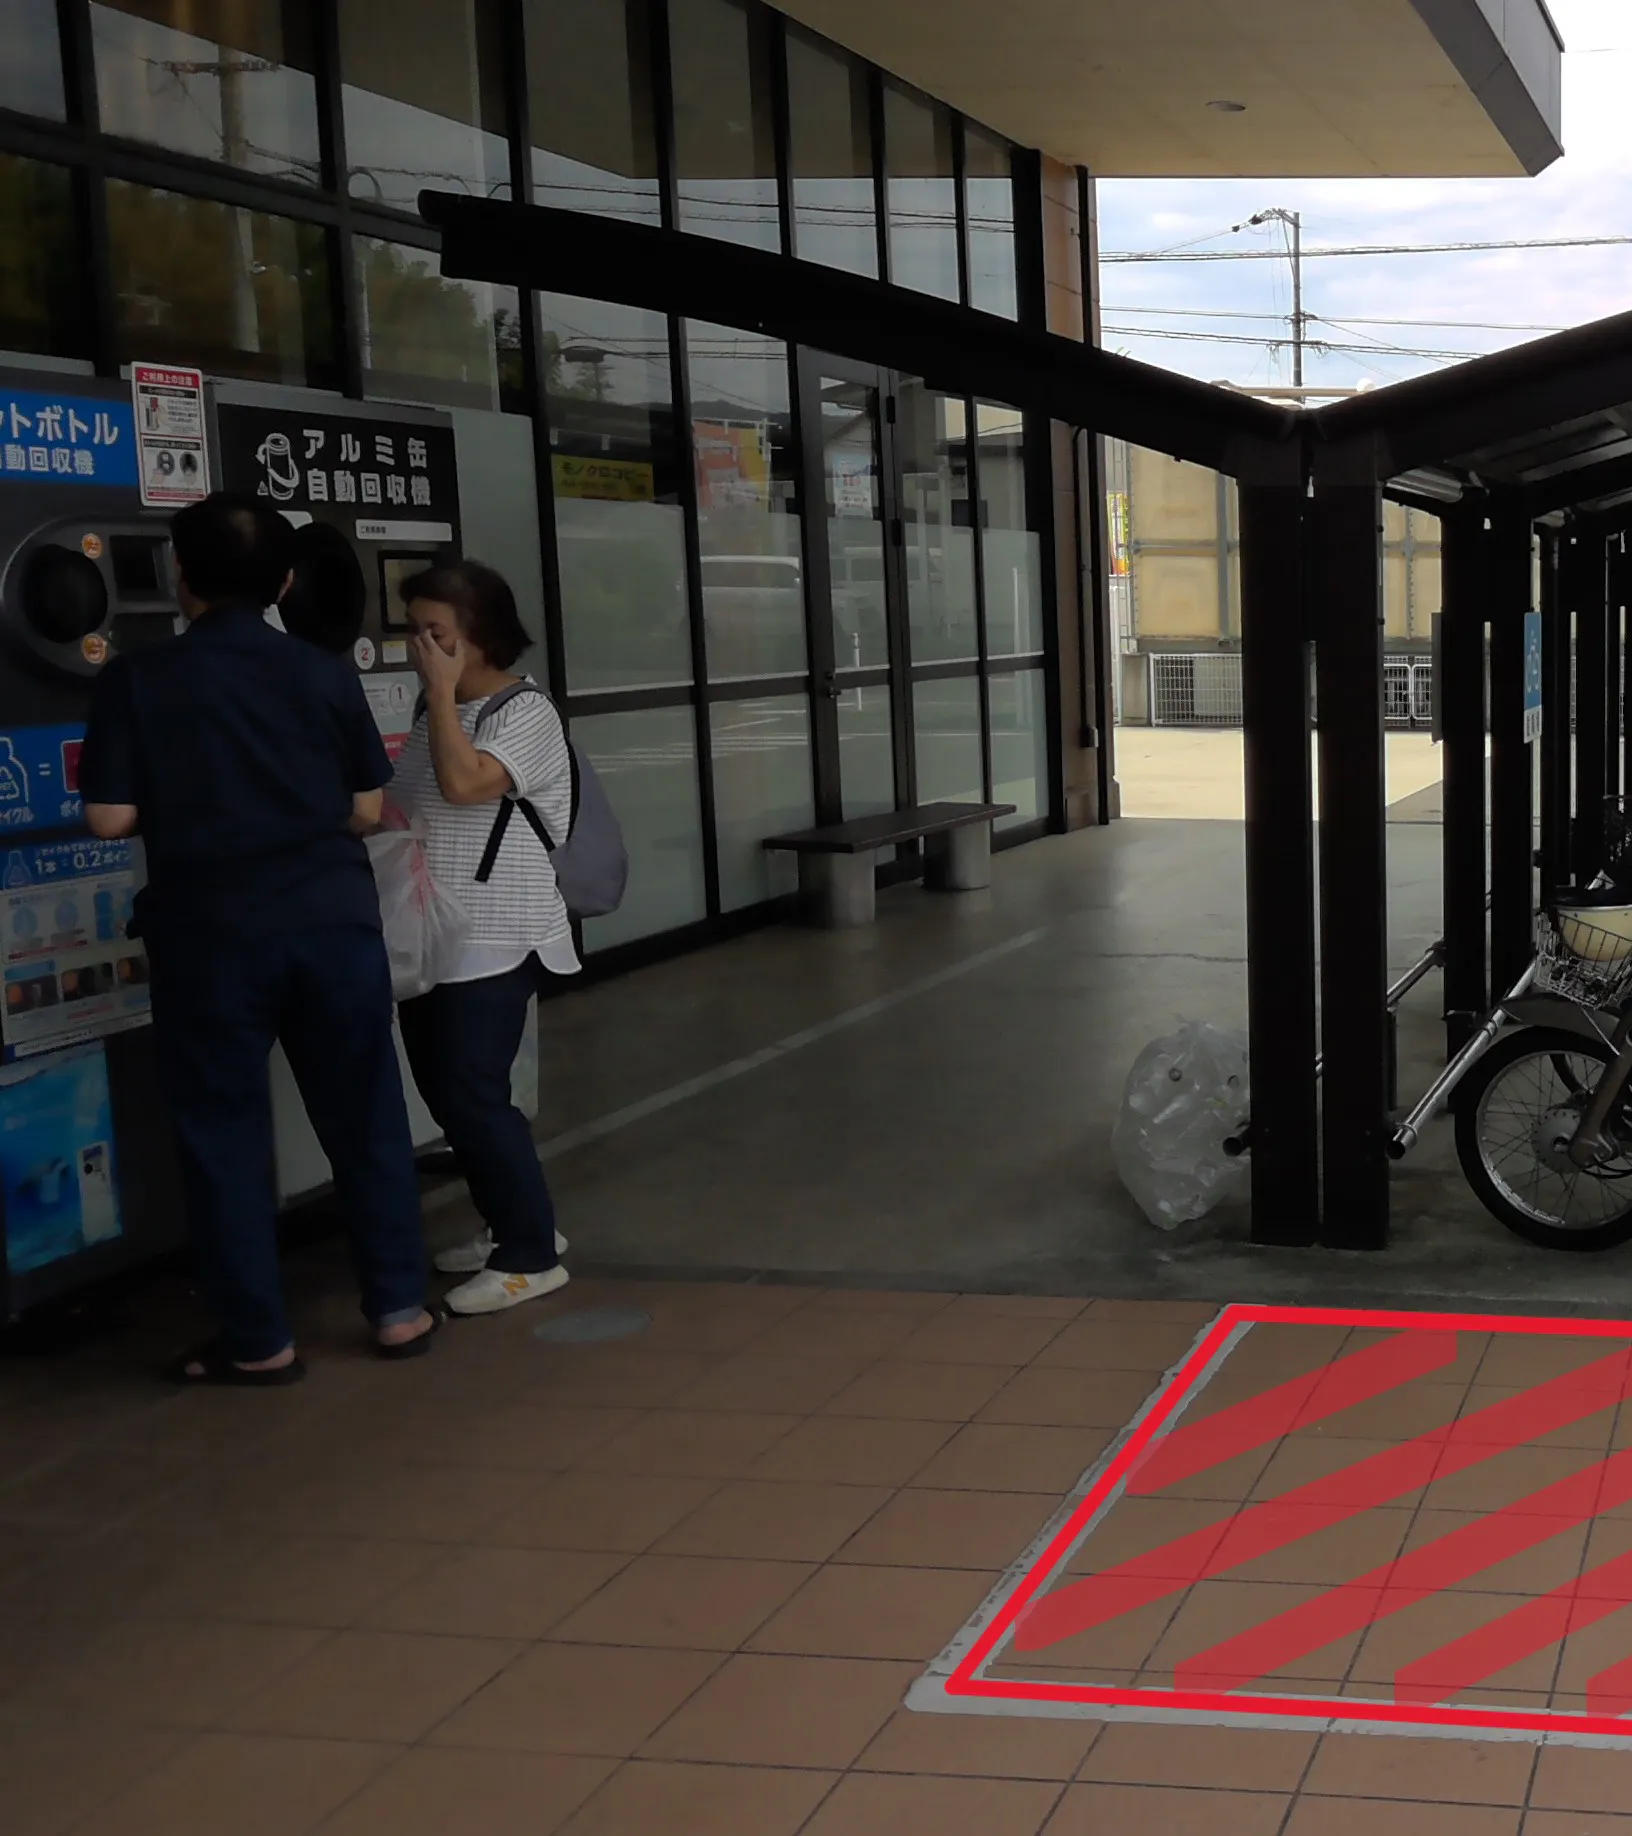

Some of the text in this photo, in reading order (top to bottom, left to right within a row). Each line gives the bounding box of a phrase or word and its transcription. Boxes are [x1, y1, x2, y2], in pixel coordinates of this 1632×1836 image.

[0, 402, 119, 446] トボトル
[0, 443, 95, 476] 動回収機
[302, 428, 428, 469] アルミ缶
[306, 468, 432, 506] 自動回収機
[361, 647, 369, 661] 2
[0, 805, 34, 825] イクル
